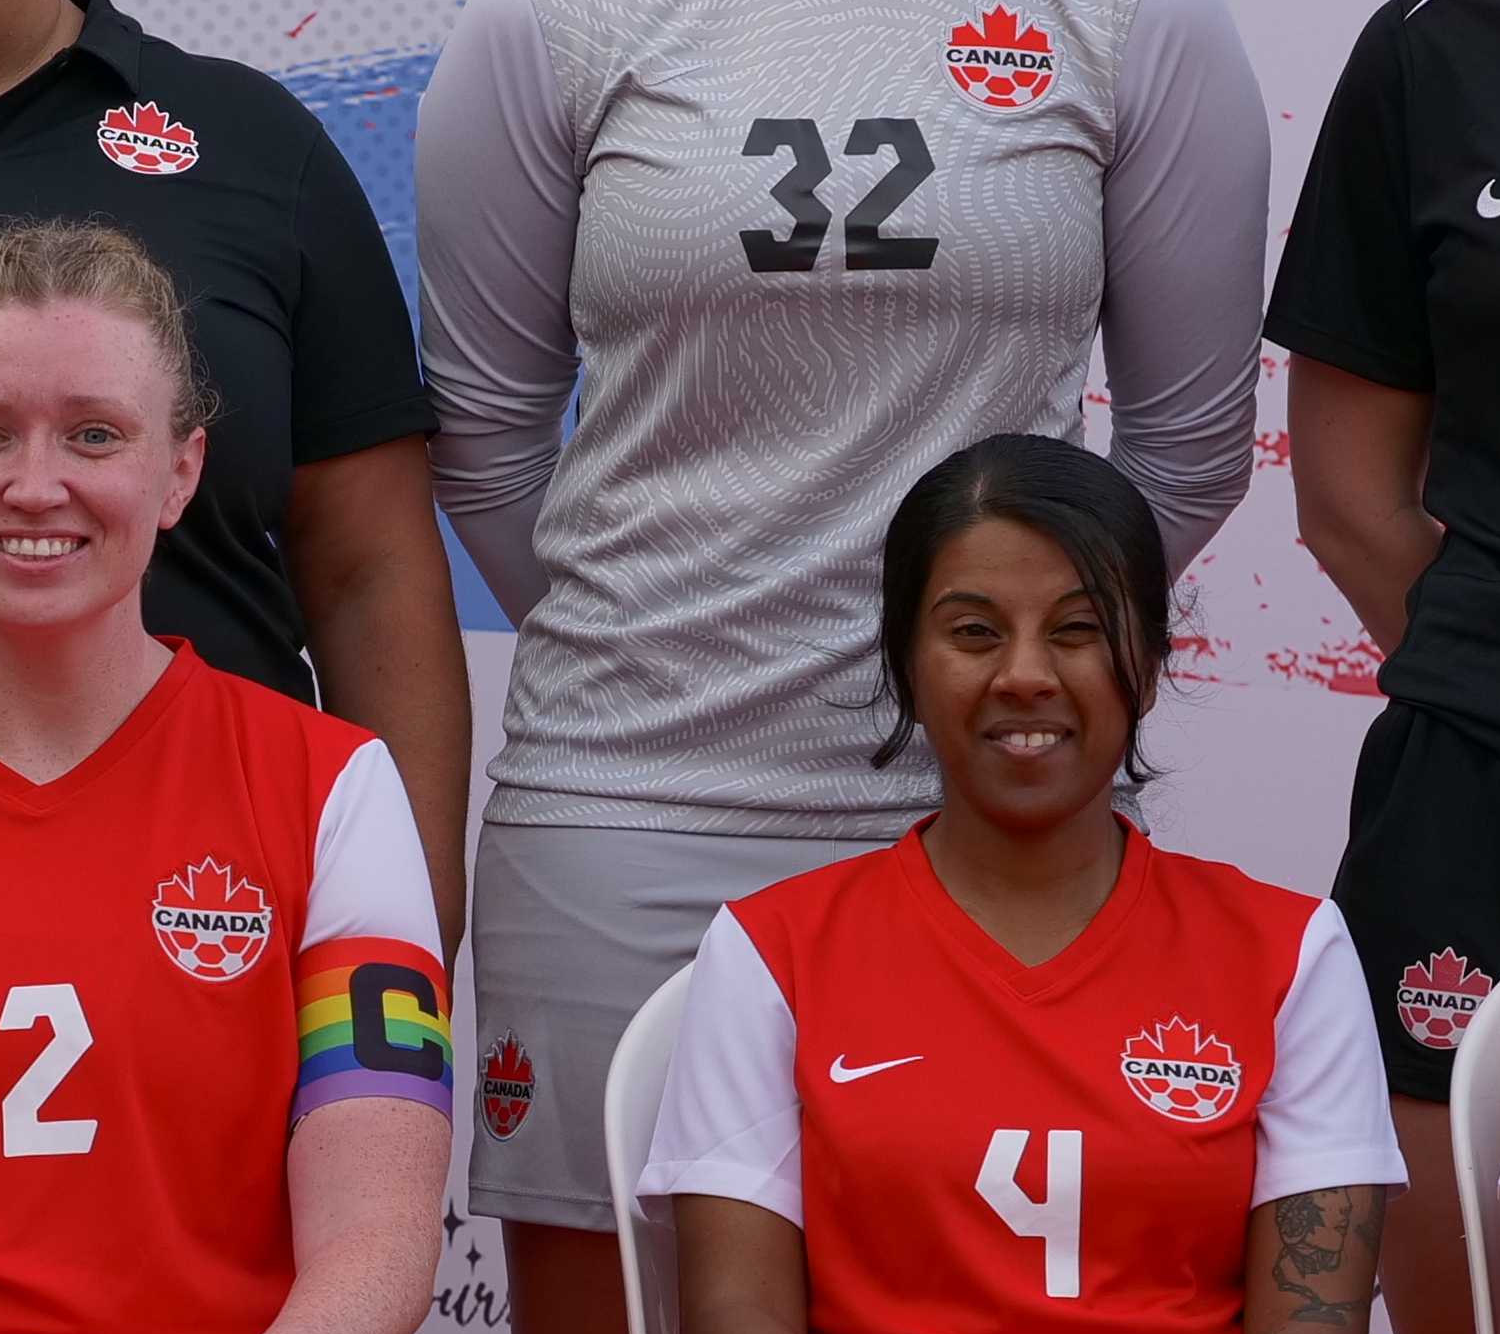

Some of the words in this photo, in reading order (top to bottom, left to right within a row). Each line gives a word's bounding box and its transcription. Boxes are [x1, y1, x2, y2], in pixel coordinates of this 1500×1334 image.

[945, 47, 1054, 72] CANADA
[99, 127, 197, 159] CANADA
[738, 118, 940, 273] 32
[156, 907, 266, 935] CANADA
[1399, 989, 1482, 1012] CANAD
[349, 962, 443, 1081] C
[0, 983, 98, 1158] 2
[1125, 1058, 1237, 1087] CANADA
[483, 1080, 531, 1099] CANADA
[975, 1129, 1082, 1299] 4
